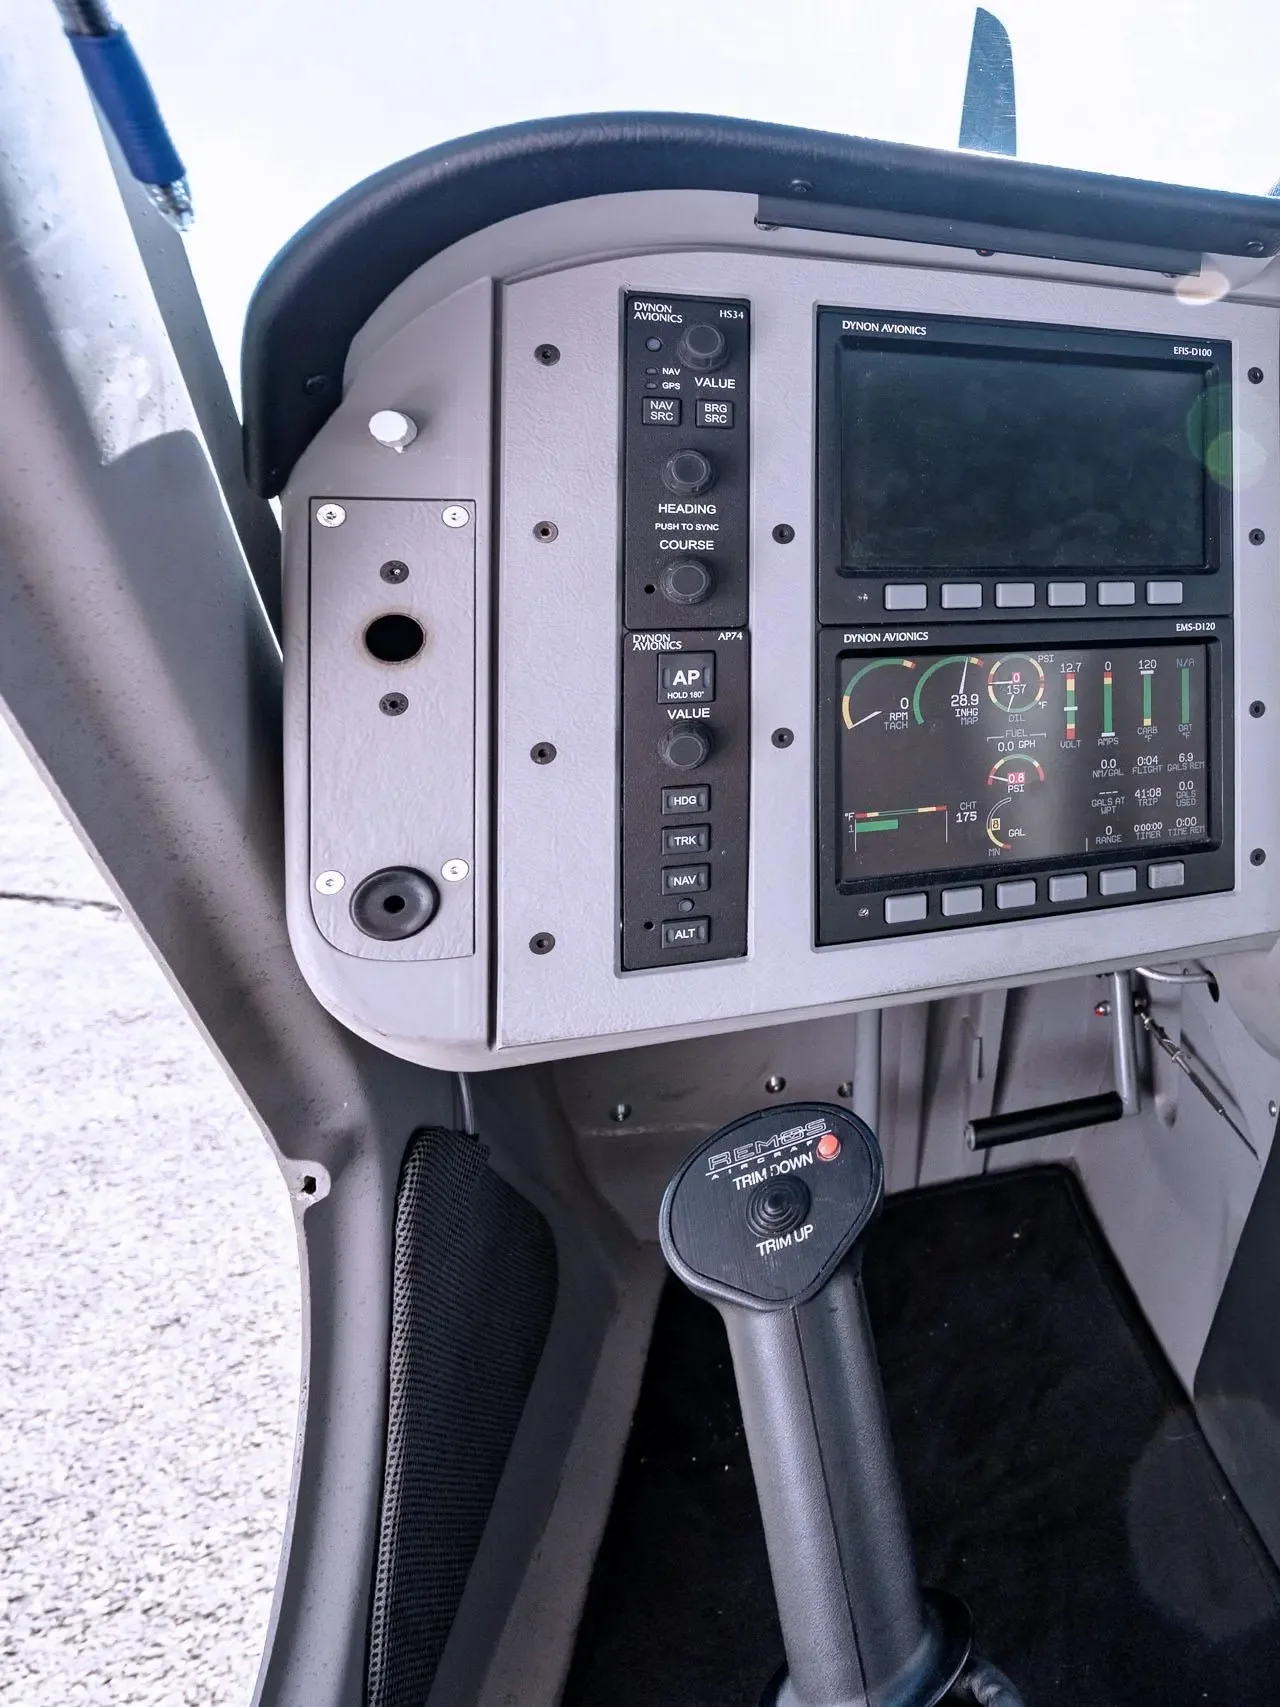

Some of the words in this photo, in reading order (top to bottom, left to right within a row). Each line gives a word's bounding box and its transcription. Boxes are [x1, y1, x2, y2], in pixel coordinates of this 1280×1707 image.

[634, 301, 672, 313] DYNON
[633, 311, 683, 324] AVIONICS
[719, 309, 744, 320] HS34
[842, 320, 879, 333] DYNON
[881, 322, 927, 336] AVIONICS
[1173, 346, 1213, 358] EFIS-D100
[662, 367, 681, 376] NAV
[662, 381, 681, 390] GPS
[694, 376, 736, 389] VALUE
[650, 401, 674, 410] NAV
[704, 403, 728, 413] BRG
[650, 411, 674, 421] SRC
[704, 414, 728, 424] SRC
[658, 503, 717, 515] HEADING
[655, 523, 680, 531] PUSH
[681, 523, 694, 531] TO
[695, 523, 720, 531] SYNC
[659, 539, 715, 551] COURSE
[1176, 622, 1216, 633] EMS-D120
[632, 634, 671, 643] DYNON
[717, 632, 744, 641] AP74
[843, 634, 882, 644] DYNON
[883, 631, 929, 642] AVIONICS
[632, 641, 683, 651] AVIONICS
[1037, 655, 1055, 663] PSI
[1138, 659, 1158, 670] 120
[1176, 658, 1195, 667] N/A
[1060, 663, 1083, 673] 12.7
[1104, 661, 1112, 672] 0
[672, 669, 701, 686] AP
[1013, 673, 1021, 683] 0
[1006, 684, 1027, 695] 157
[667, 692, 689, 700] HOLD
[950, 694, 980, 708] 28.9
[900, 697, 909, 710] 0
[667, 707, 711, 720] VALUE
[889, 712, 909, 722] RPM
[955, 708, 979, 718] INHG
[884, 721, 909, 731] TACH
[961, 717, 979, 726] MAP
[1005, 729, 1028, 739] FUEL
[1137, 727, 1158, 735] CARB
[997, 741, 1015, 752] 0.0
[1018, 740, 1037, 750] GPH
[1060, 740, 1083, 749] VOLT
[1097, 737, 1119, 747] AMPS
[1137, 755, 1159, 767] 0:04
[1178, 752, 1194, 763] 6.9
[1100, 759, 1117, 770] 0.0
[1132, 765, 1163, 775] FLIGHT
[1167, 763, 1188, 773] GALS
[1189, 761, 1205, 770] REM
[1093, 769, 1124, 779] NM/GAL
[1007, 784, 1025, 794] PSI
[1178, 781, 1194, 791] 0.0
[1135, 787, 1162, 799] 41:08
[1176, 791, 1196, 800] GALS
[673, 796, 697, 806] HDG
[959, 801, 978, 811] CHT
[1091, 799, 1113, 808] GALS
[1115, 796, 1126, 805] AT
[1137, 798, 1159, 807] TRIP
[1176, 799, 1196, 808] USED
[1100, 806, 1117, 815] WPT
[955, 811, 979, 824] 175
[1176, 817, 1197, 828] 0:00
[993, 819, 1000, 830] 8
[1133, 822, 1163, 833] 0:00:00
[1008, 828, 1026, 838] GAL
[1105, 825, 1113, 836] 0
[1136, 830, 1161, 841] TIMER
[1168, 827, 1189, 837] TIME
[1189, 825, 1206, 835] REM
[674, 836, 697, 847] TRK
[1096, 835, 1123, 845] RANGE
[673, 875, 697, 886] NAV
[674, 928, 696, 940] ALT
[708, 1119, 828, 1171] REMOS
[733, 1170, 768, 1191] TRIM
[769, 1152, 814, 1178] DOWN
[756, 1232, 792, 1257] TRIM
[794, 1224, 815, 1243] UP
